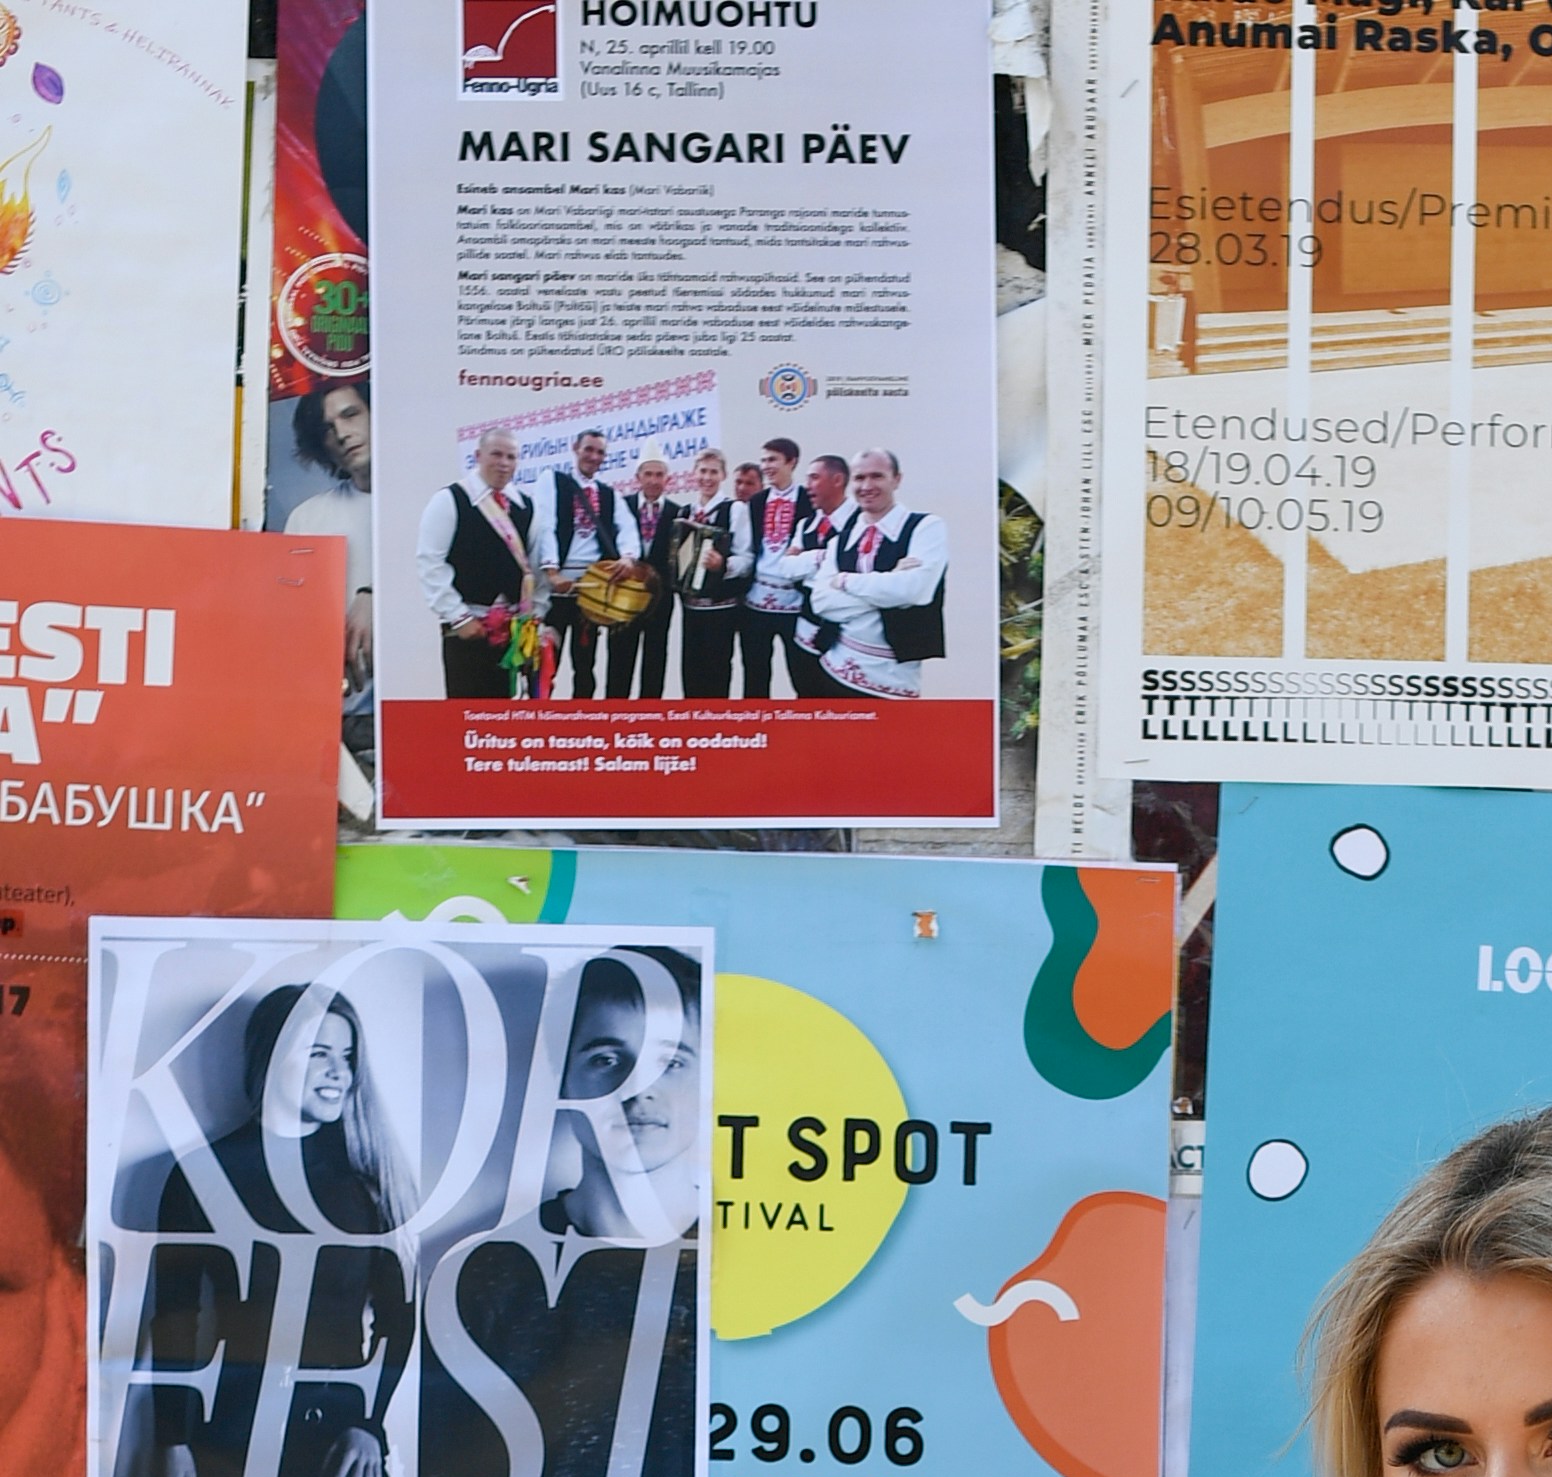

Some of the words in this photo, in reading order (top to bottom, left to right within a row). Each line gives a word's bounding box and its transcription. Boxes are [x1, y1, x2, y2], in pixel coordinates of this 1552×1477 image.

[579, 40, 601, 58] N,
[605, 40, 631, 56] 25.
[638, 40, 691, 60] aprillil
[694, 40, 723, 57] kell
[728, 40, 776, 56] 19.00
[1151, 13, 1337, 50] Anumai
[1354, 19, 1513, 61] Raska,
[579, 60, 662, 77] Vanalinna
[665, 61, 781, 82] Muusikamajas
[462, 79, 560, 97] Fenno-Ugria
[580, 80, 618, 98] (Uus
[624, 82, 644, 97] 16
[666, 82, 726, 100] Tallinn)
[457, 131, 571, 163] MARI
[587, 131, 785, 164] SANGARI
[802, 123, 912, 165] PÄEV
[1148, 231, 1323, 268] 28.03.19
[458, 368, 604, 392] fennougria.ee
[1144, 446, 1377, 488] 18/19.04.19
[1144, 492, 1385, 533] 09/10.05.19
[464, 730, 517, 750] Üritus
[521, 735, 543, 749] on
[548, 734, 609, 751] tasuta,
[614, 733, 655, 749] kõik
[659, 735, 682, 749] on
[686, 733, 768, 750] oodatud!
[464, 757, 503, 773] Tere
[507, 756, 589, 773] tulemast!
[594, 756, 650, 772] Salam
[787, 1115, 992, 1187] SPOT
[709, 1402, 925, 1467] 29.06
